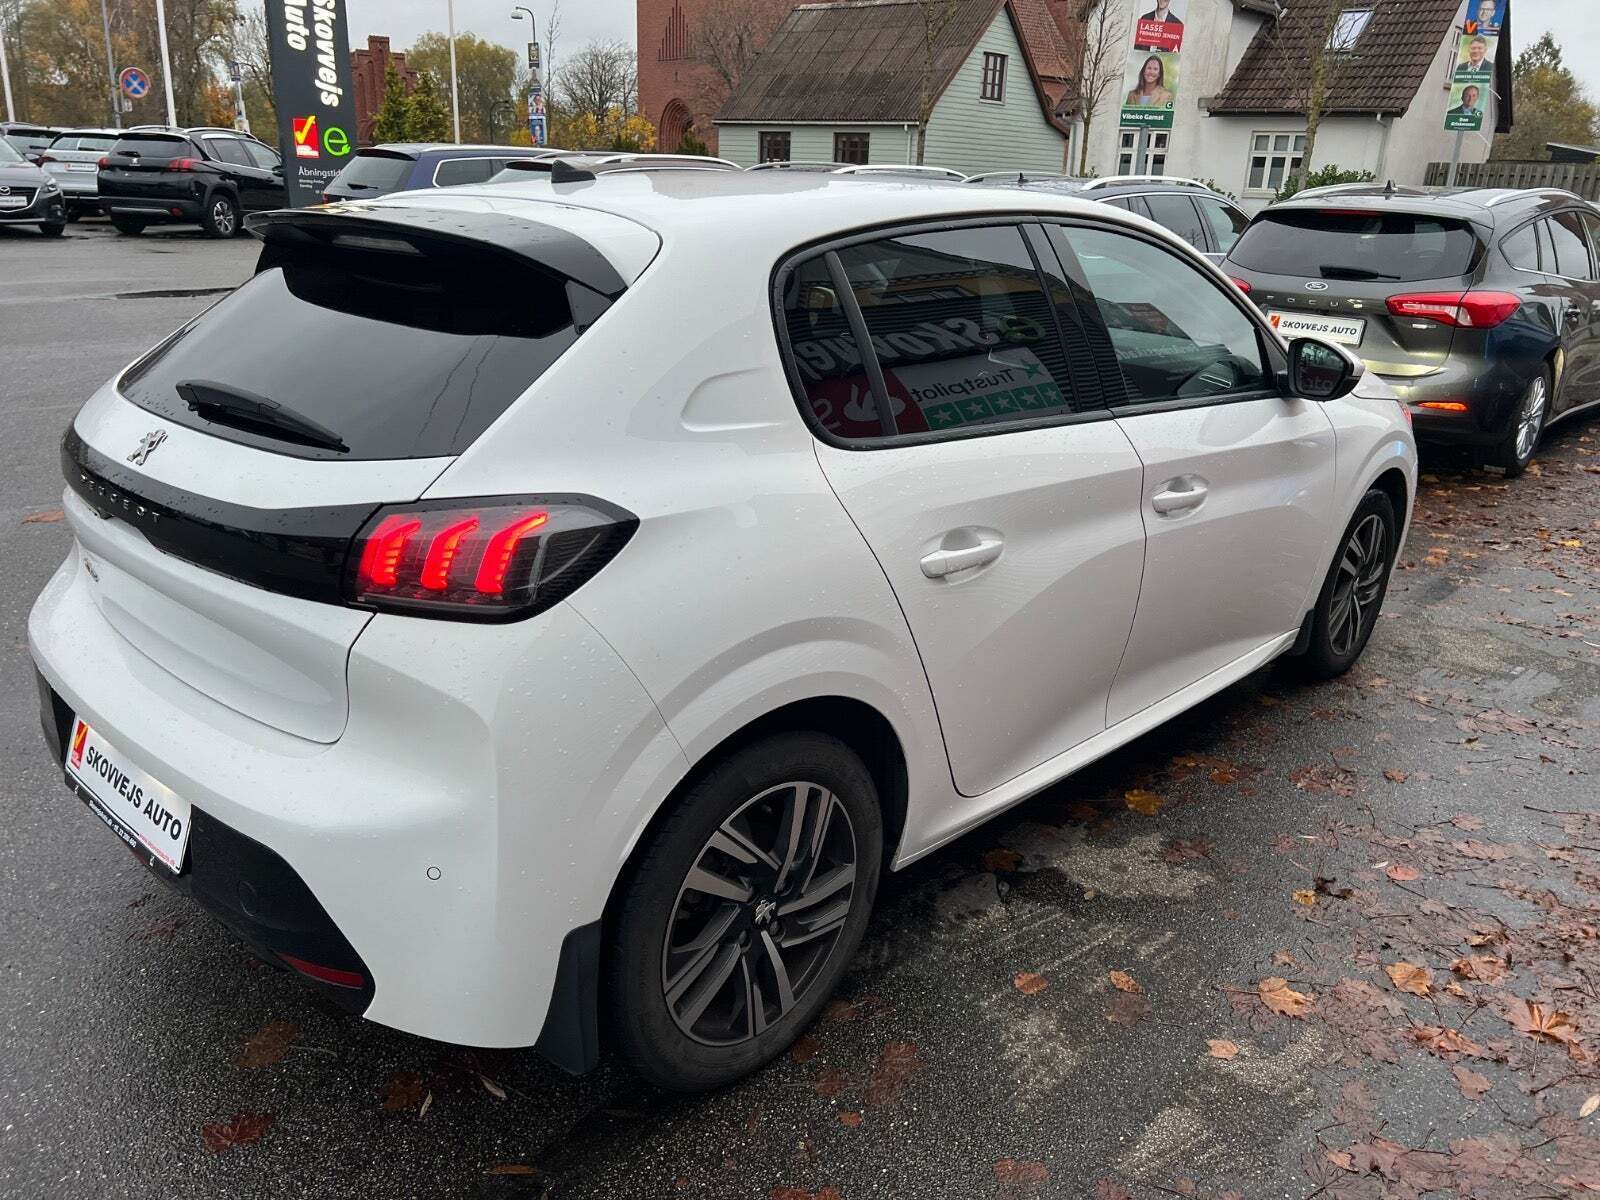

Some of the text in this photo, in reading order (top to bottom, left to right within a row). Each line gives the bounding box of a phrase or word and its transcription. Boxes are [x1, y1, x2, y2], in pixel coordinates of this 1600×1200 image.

[1140, 23, 1163, 32] LASSE
[1282, 320, 1357, 335] SKOVVEJS AUTO
[86, 746, 143, 809] SKOVVEJS
[143, 798, 182, 841] AUTO
